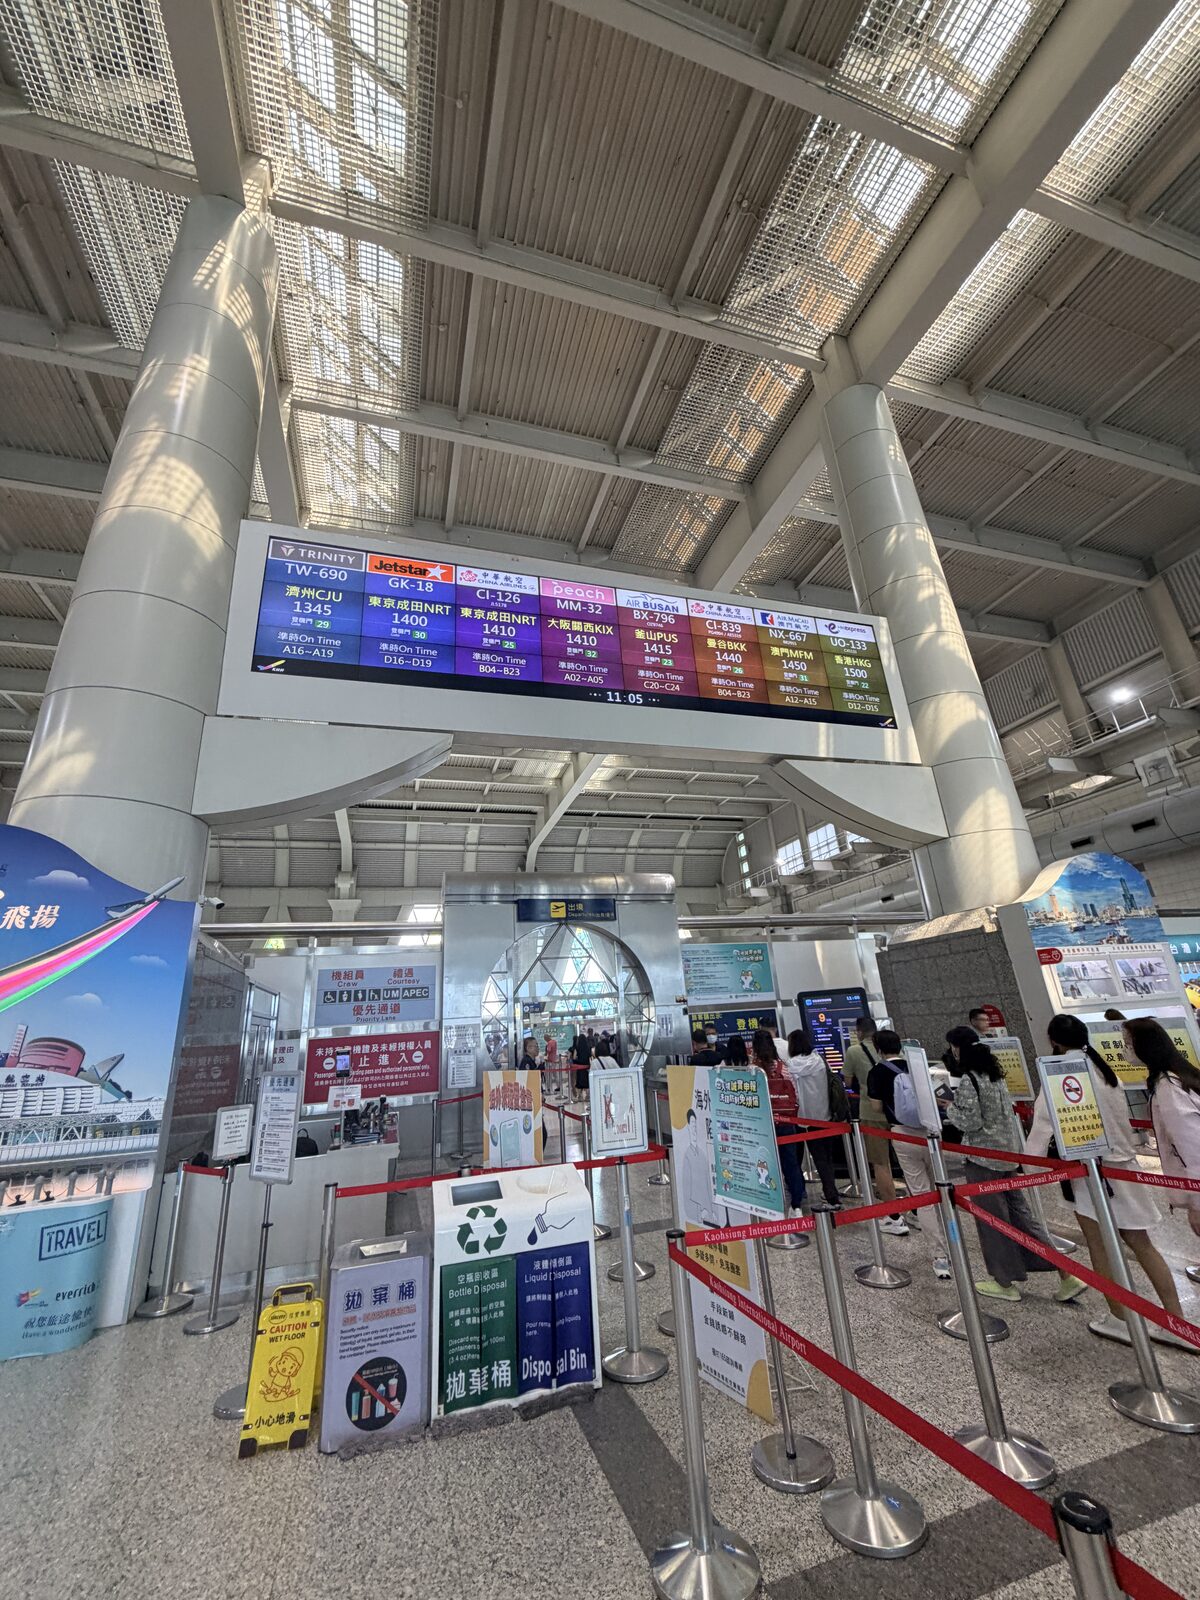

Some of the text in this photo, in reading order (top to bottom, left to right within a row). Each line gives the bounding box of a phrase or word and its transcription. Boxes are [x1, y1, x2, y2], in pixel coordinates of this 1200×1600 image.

[299, 548, 356, 565] TRINITY
[285, 563, 348, 581] TW-690
[374, 560, 429, 576] Jetstar
[482, 572, 523, 585] 中華航空
[388, 578, 434, 593] GK-18
[499, 581, 527, 590] AIRLINES
[552, 582, 605, 600] peach
[286, 585, 342, 602] 濟州CJU
[476, 589, 521, 604] CI-126
[293, 601, 332, 616] 1345
[368, 596, 452, 615] 東京成田NRT
[556, 599, 602, 615] MM-32
[625, 599, 679, 613] AIR BUSAN
[392, 613, 428, 627] 1400
[460, 607, 537, 626] 東京成田NRT
[633, 610, 675, 624] BX-796
[316, 620, 330, 628] 29
[482, 623, 516, 637] 1410
[548, 618, 614, 635] 大阪關西KIX
[706, 620, 742, 633] CI-839
[317, 636, 341, 646] Time
[566, 633, 597, 646] 1410
[769, 629, 807, 642] NX-667
[504, 641, 515, 649] 25
[643, 642, 672, 655] 1415
[830, 637, 867, 651] UO-133
[282, 645, 334, 658] A16~A19
[415, 647, 438, 656] Time
[586, 650, 597, 658] 32
[715, 651, 742, 664] 1440
[770, 646, 813, 660] 澳門MFM
[384, 656, 432, 668] D16~D19
[505, 656, 527, 665] Time
[782, 660, 807, 671] 1450
[835, 655, 872, 668] 香港HKG
[479, 665, 520, 676] B04~B23
[589, 665, 608, 674] Time
[844, 668, 868, 679] 1500
[564, 673, 604, 684] A02~A05
[666, 673, 684, 681] Time
[643, 680, 680, 691] C20~C24
[737, 681, 754, 689] Time
[606, 691, 643, 704] 11:05
[718, 689, 751, 699] B04~B23
[803, 688, 820, 696] Time
[785, 696, 817, 705] A12~A15
[848, 702, 879, 712] D12~D15
[0, 905, 60, 929] 飛揚
[332, 970, 364, 981] 機組員
[393, 968, 414, 978] 禮遇
[383, 990, 400, 999] UM
[403, 988, 429, 998] APEC
[352, 1003, 401, 1017] 優先通道
[736, 1017, 759, 1030] 登機
[818, 1013, 826, 1023] 9
[315, 1040, 432, 1057] 未持機證及未經授權人員
[314, 1070, 337, 1079] Passenger
[979, 1172, 1068, 1193] Kaohsiung International Airport
[1136, 1173, 1185, 1189] Kaohsiung
[47, 1219, 104, 1253] TRAVEL
[704, 1222, 799, 1242] Kaohsiung International
[533, 1255, 572, 1271] 液體傾倒區
[457, 1268, 499, 1285] 空瓶回收區
[524, 1271, 548, 1284] Liquid
[448, 1280, 507, 1299] Bottle Disposal
[526, 1314, 581, 1329] Pour liquids
[708, 1275, 808, 1356] Kaohsiung International Airport
[269, 1321, 308, 1335] CAUTION
[269, 1332, 306, 1344] WET FLOOR
[448, 1335, 469, 1347] Discard
[448, 1343, 477, 1355] containers
[522, 1347, 587, 1383] Disposal Bin
[446, 1360, 511, 1403] 拋棄桶
[255, 1412, 296, 1428] 小心地滑
